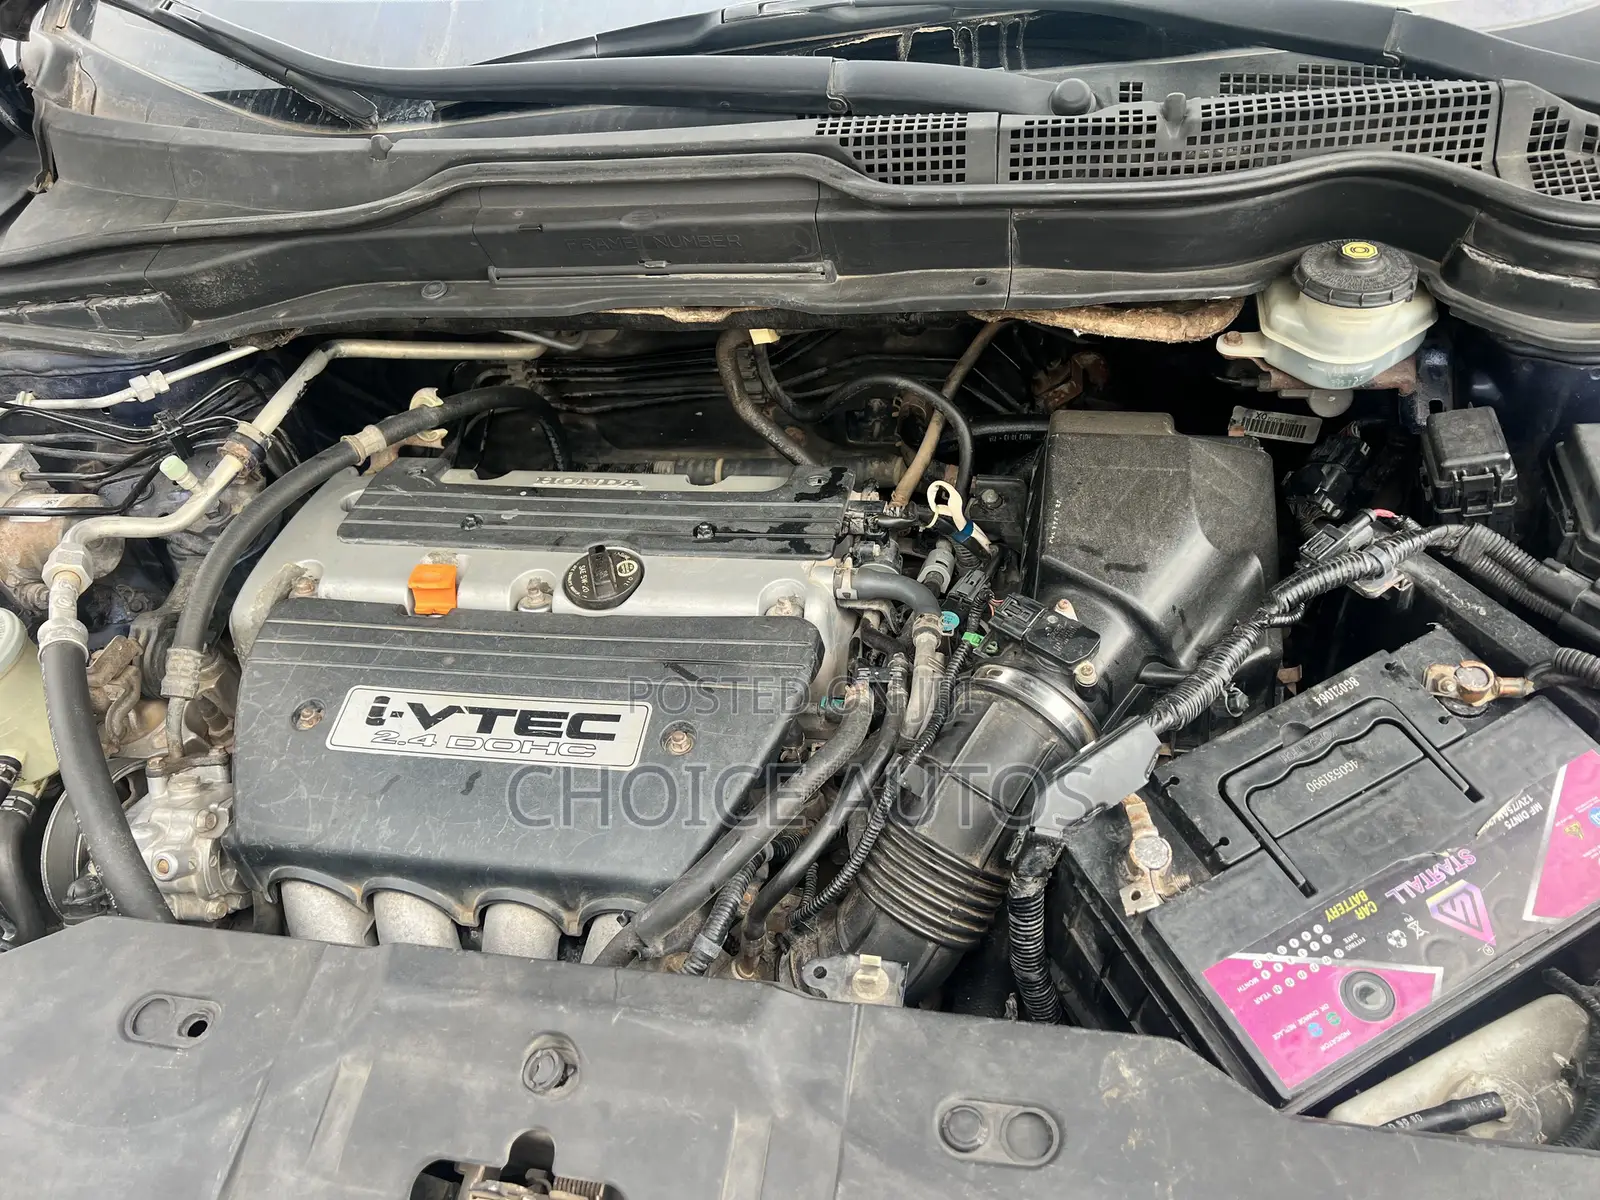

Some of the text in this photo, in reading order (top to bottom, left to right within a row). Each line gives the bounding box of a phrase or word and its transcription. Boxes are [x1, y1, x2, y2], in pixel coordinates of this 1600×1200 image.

[564, 234, 742, 250] FRAME NUMBER
[533, 476, 642, 488] HONDA
[1313, 676, 1360, 706] 8G021064
[365, 695, 622, 741] i-VTEC
[371, 730, 597, 758] 2.4 DOHC
[1306, 760, 1359, 793] 4G0531990
[1504, 801, 1544, 830] MF DIN75
[1384, 847, 1477, 905] STARTALL
[1325, 889, 1369, 923] BATTERY
[1354, 900, 1378, 920] CAR
[1342, 932, 1358, 944] DATE
[1345, 937, 1367, 951] FITTING
[1237, 977, 1260, 993] MONTH
[1254, 992, 1272, 1004] YEAR
[1320, 1029, 1352, 1052] INDICATOR
